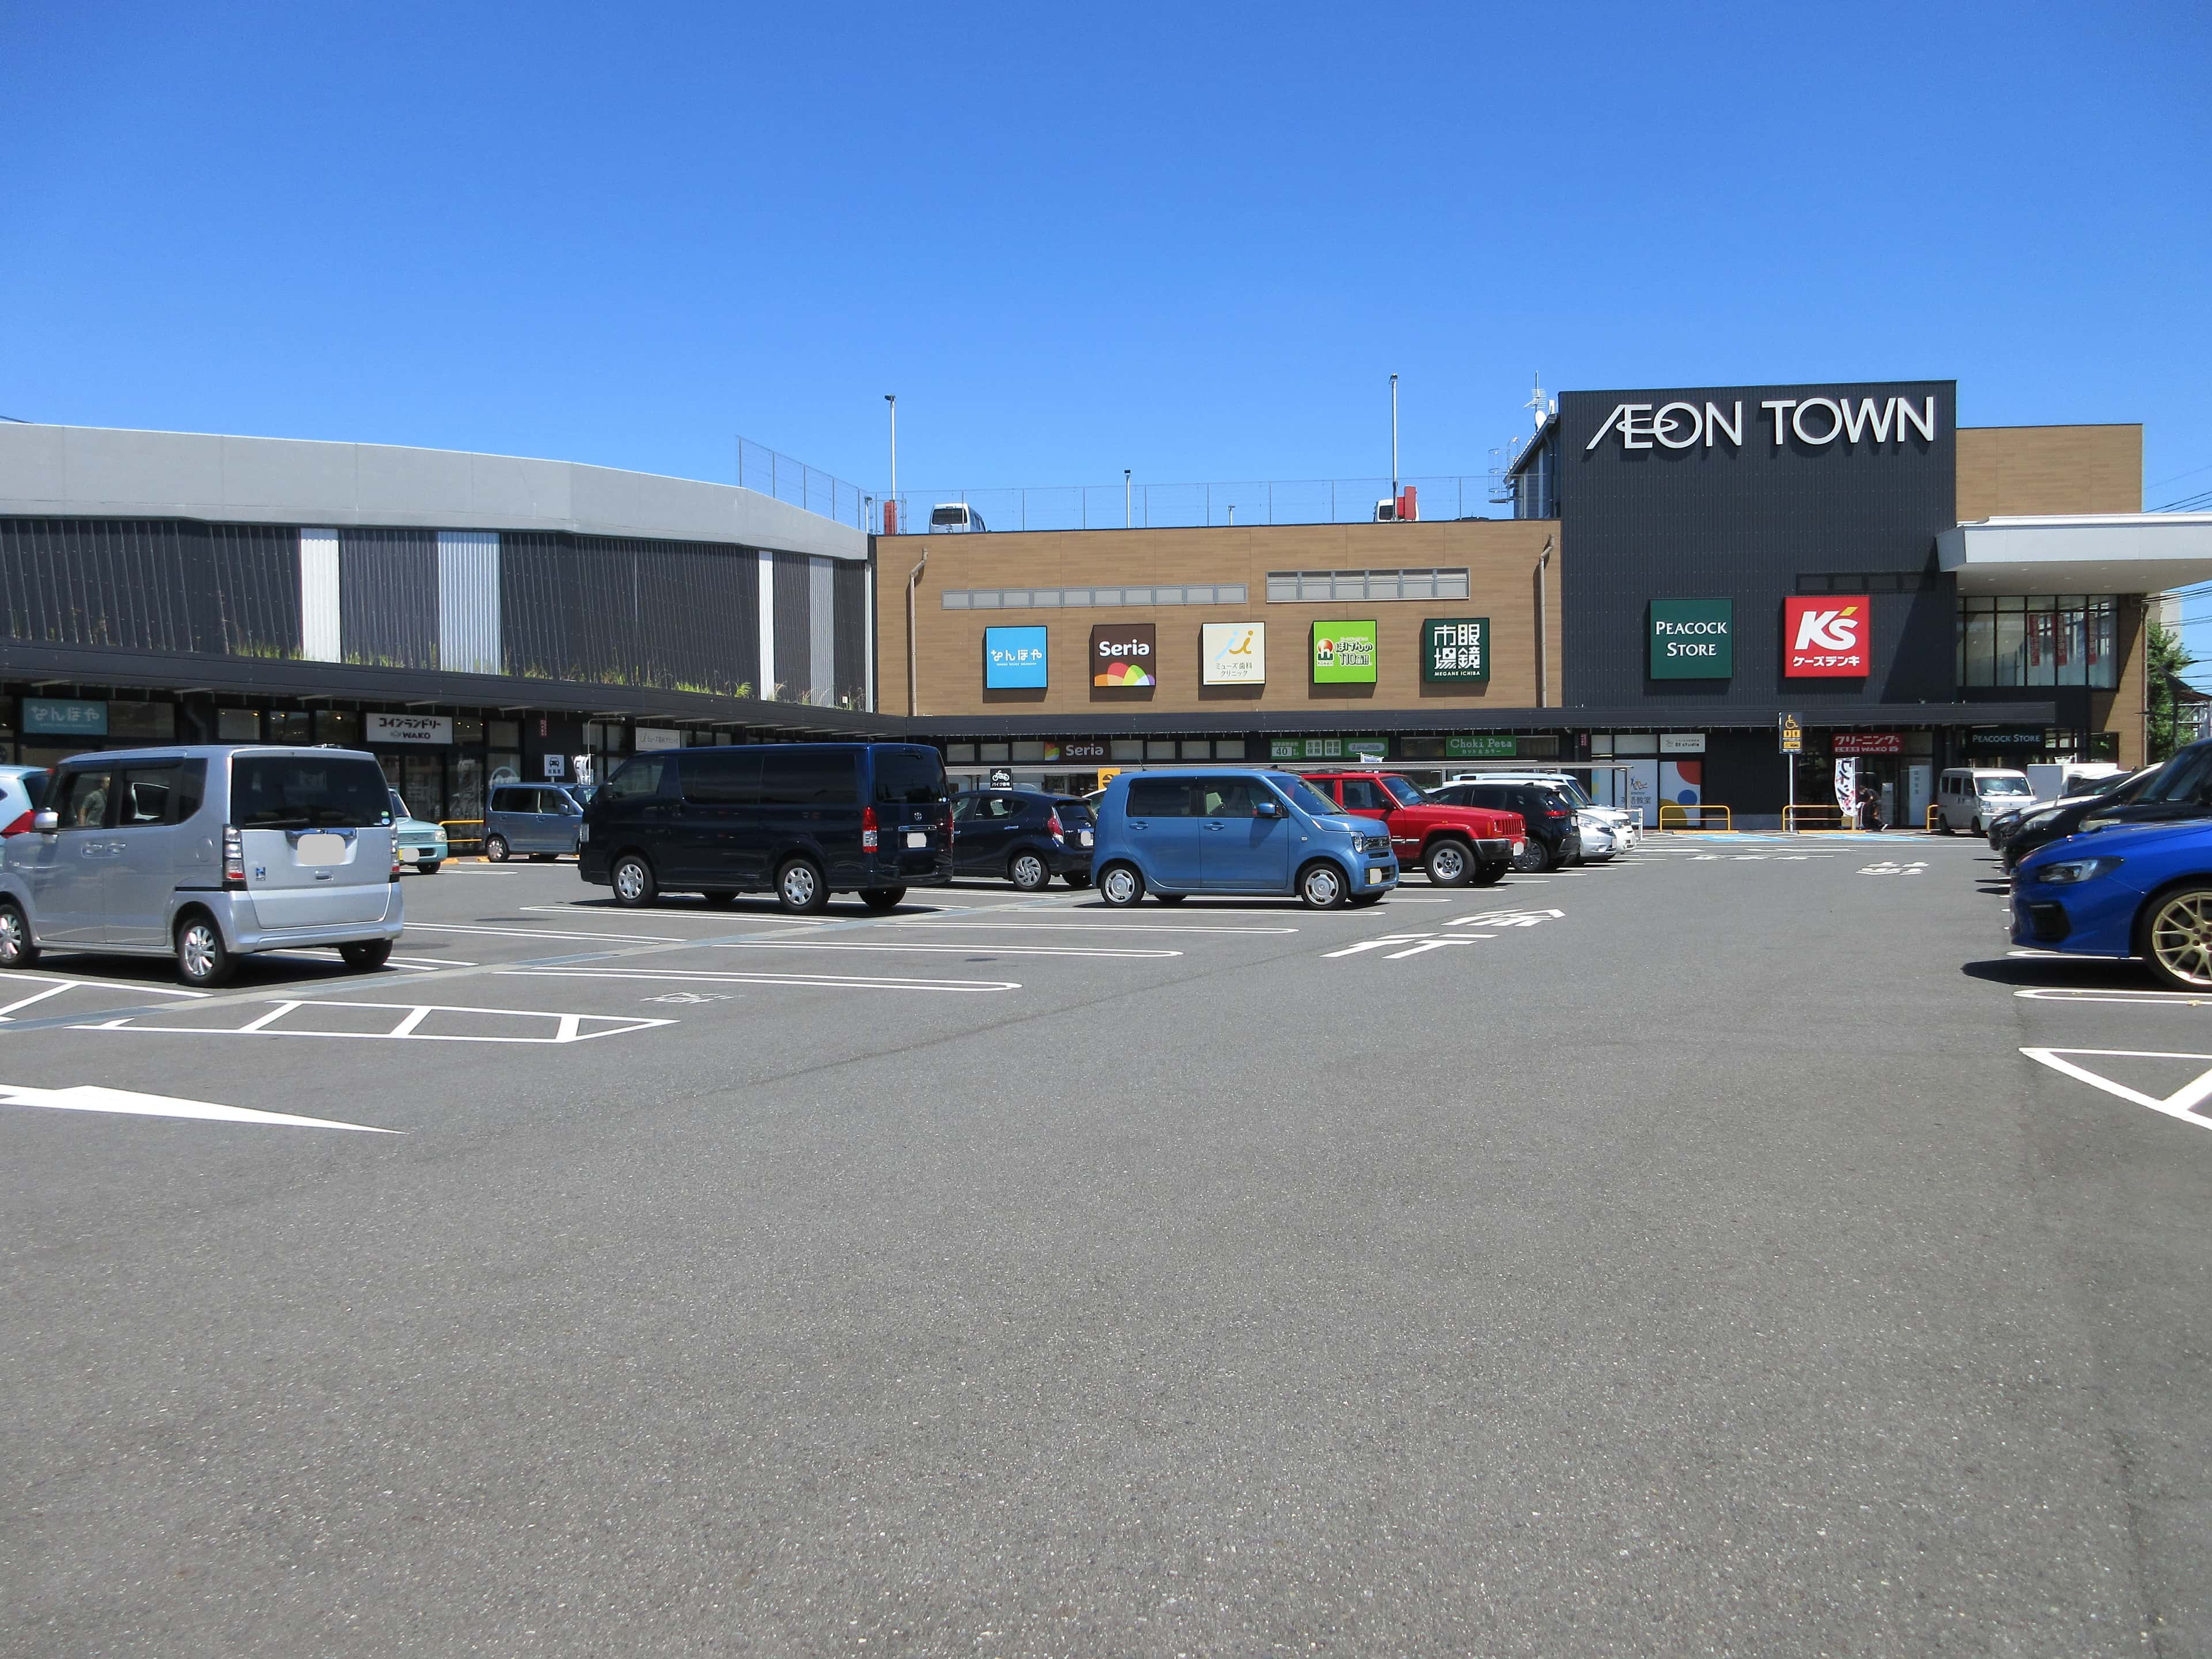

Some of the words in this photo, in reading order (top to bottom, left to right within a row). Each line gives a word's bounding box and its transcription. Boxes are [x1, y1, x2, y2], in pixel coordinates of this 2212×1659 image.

[1762, 396, 1934, 445] TOWN
[1099, 639, 1150, 656] Seria
[1335, 641, 1373, 652] ほけんの
[1216, 662, 1252, 670] ミューズ歯科
[1793, 656, 1861, 667] ケーズデンキ
[379, 718, 441, 729] コインランドリー
[1450, 738, 1484, 748] Choki
[1487, 738, 1512, 748] Peta
[1835, 736, 1899, 745] クリーニング
[1066, 743, 1104, 756] Seria
